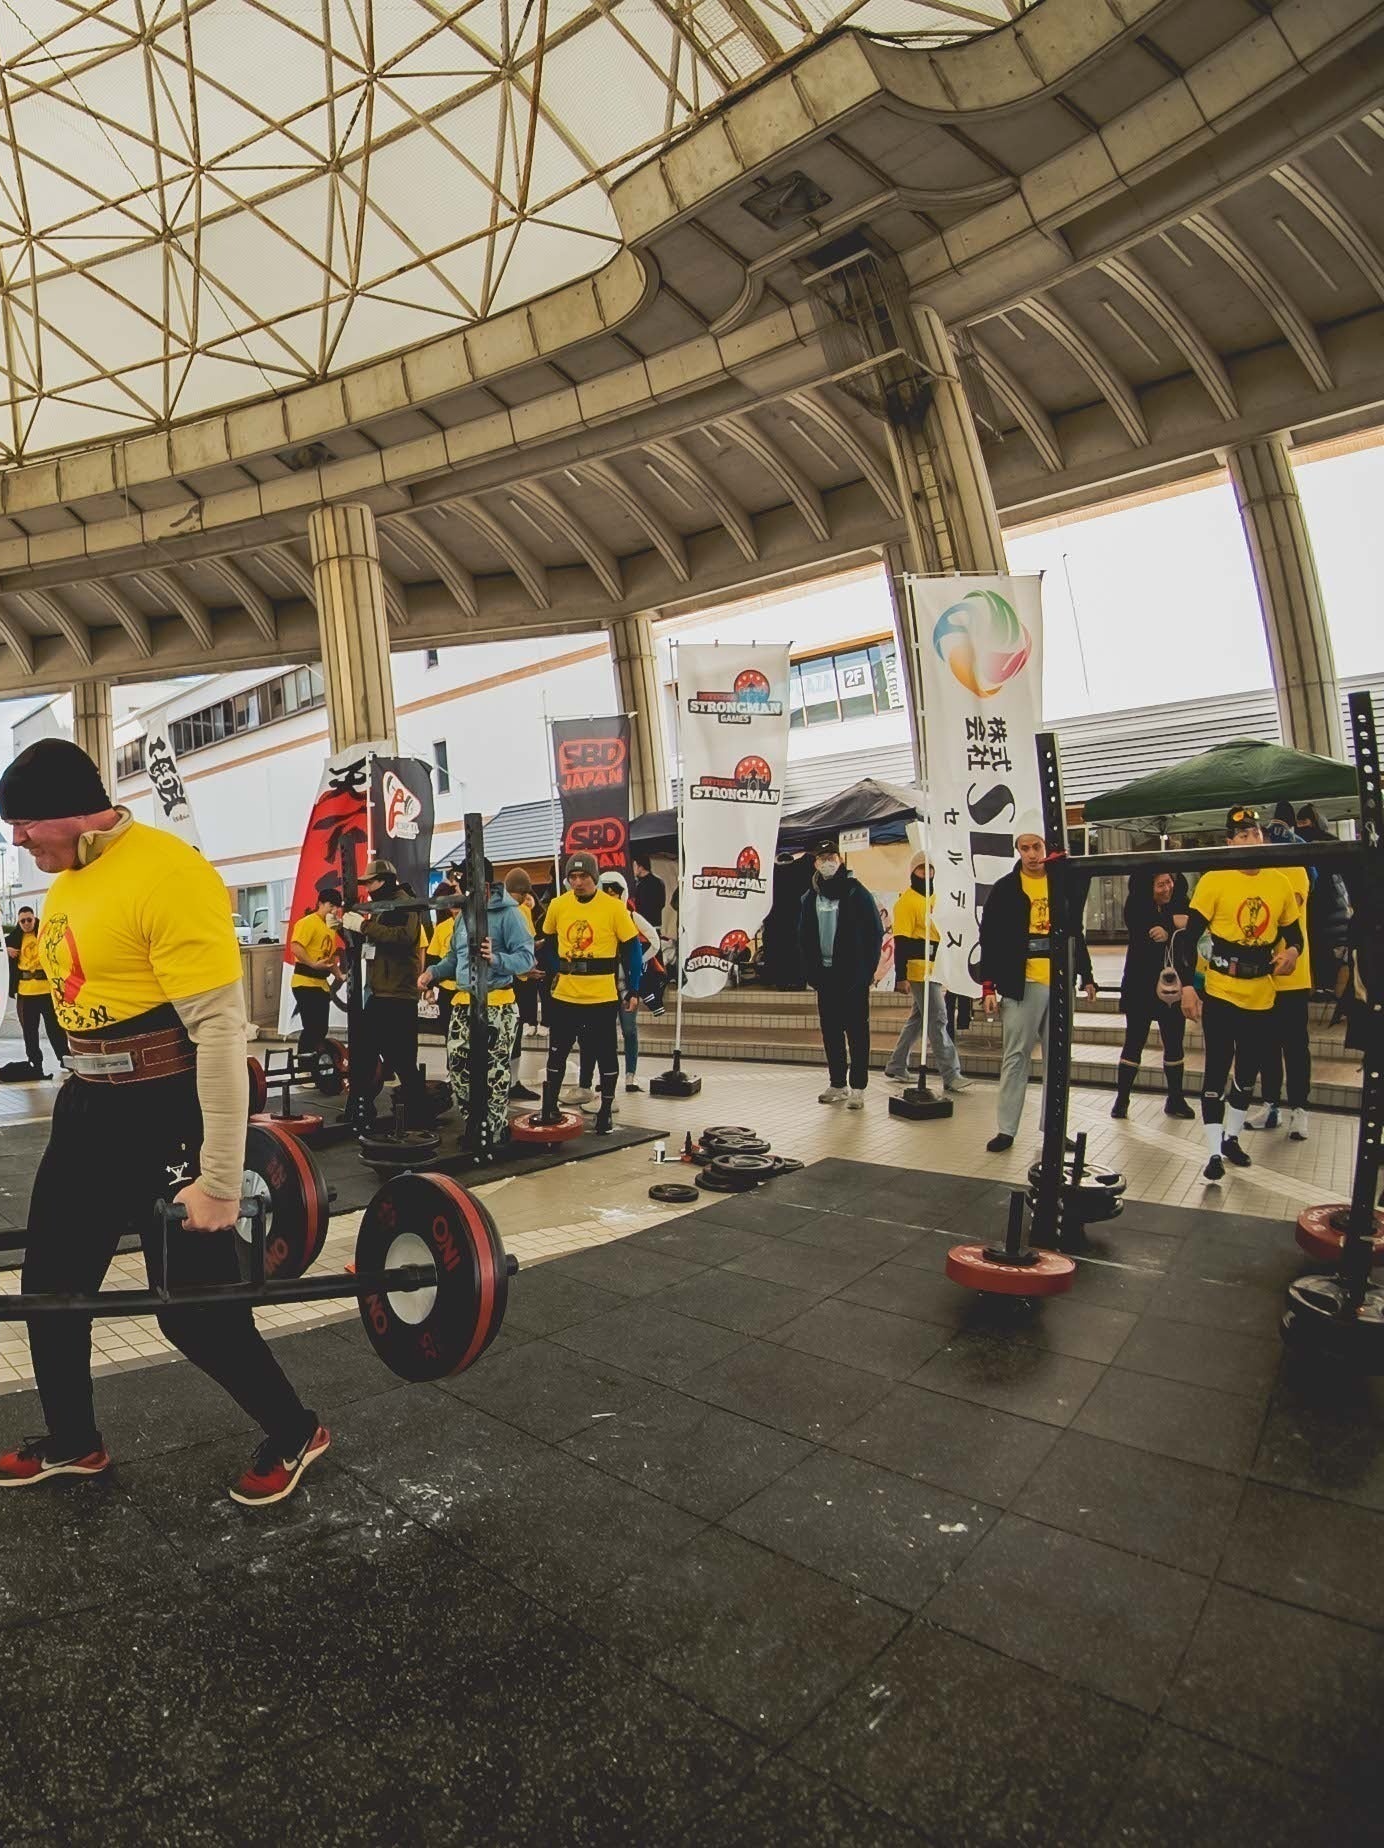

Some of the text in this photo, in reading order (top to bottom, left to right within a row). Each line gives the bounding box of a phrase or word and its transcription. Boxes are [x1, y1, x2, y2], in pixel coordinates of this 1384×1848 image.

[846, 669, 863, 687] 2F
[689, 700, 781, 715] STRONGMAN
[719, 713, 750, 723] GAMES
[564, 743, 619, 769] SBD
[561, 767, 623, 791] JAPAN
[691, 785, 780, 803] STRONGMAN
[568, 822, 622, 850] SBD
[718, 888, 745, 898] GAMES
[366, 1294, 388, 1335] ON
